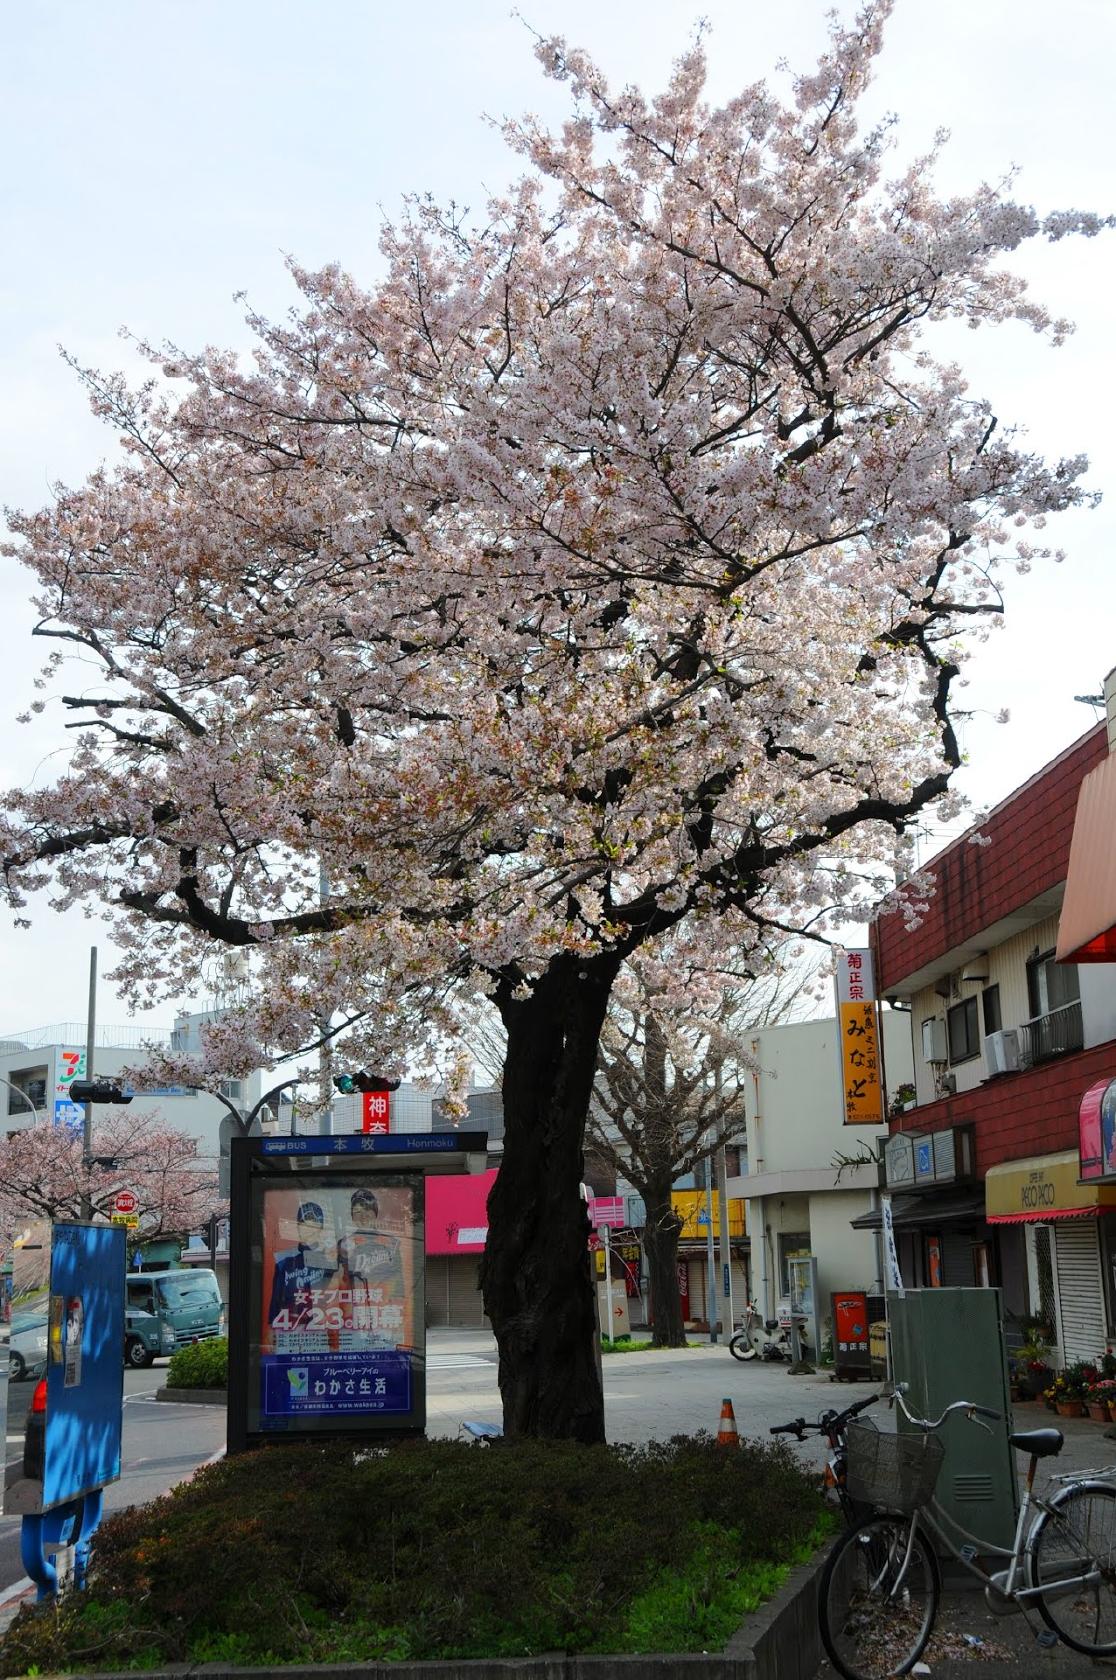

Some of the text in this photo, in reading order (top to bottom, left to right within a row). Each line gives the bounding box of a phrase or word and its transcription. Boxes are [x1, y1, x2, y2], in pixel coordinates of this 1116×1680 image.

[847, 953, 865, 1000] 菊正宗
[847, 1019, 867, 1098] みなと
[287, 1141, 307, 1151] BUS
[406, 1138, 454, 1149] Honmoku
[293, 1288, 384, 1304] 女子プロ野球
[323, 1367, 379, 1377] ブルーベリーアイの
[314, 1377, 387, 1396] わかさ生活
